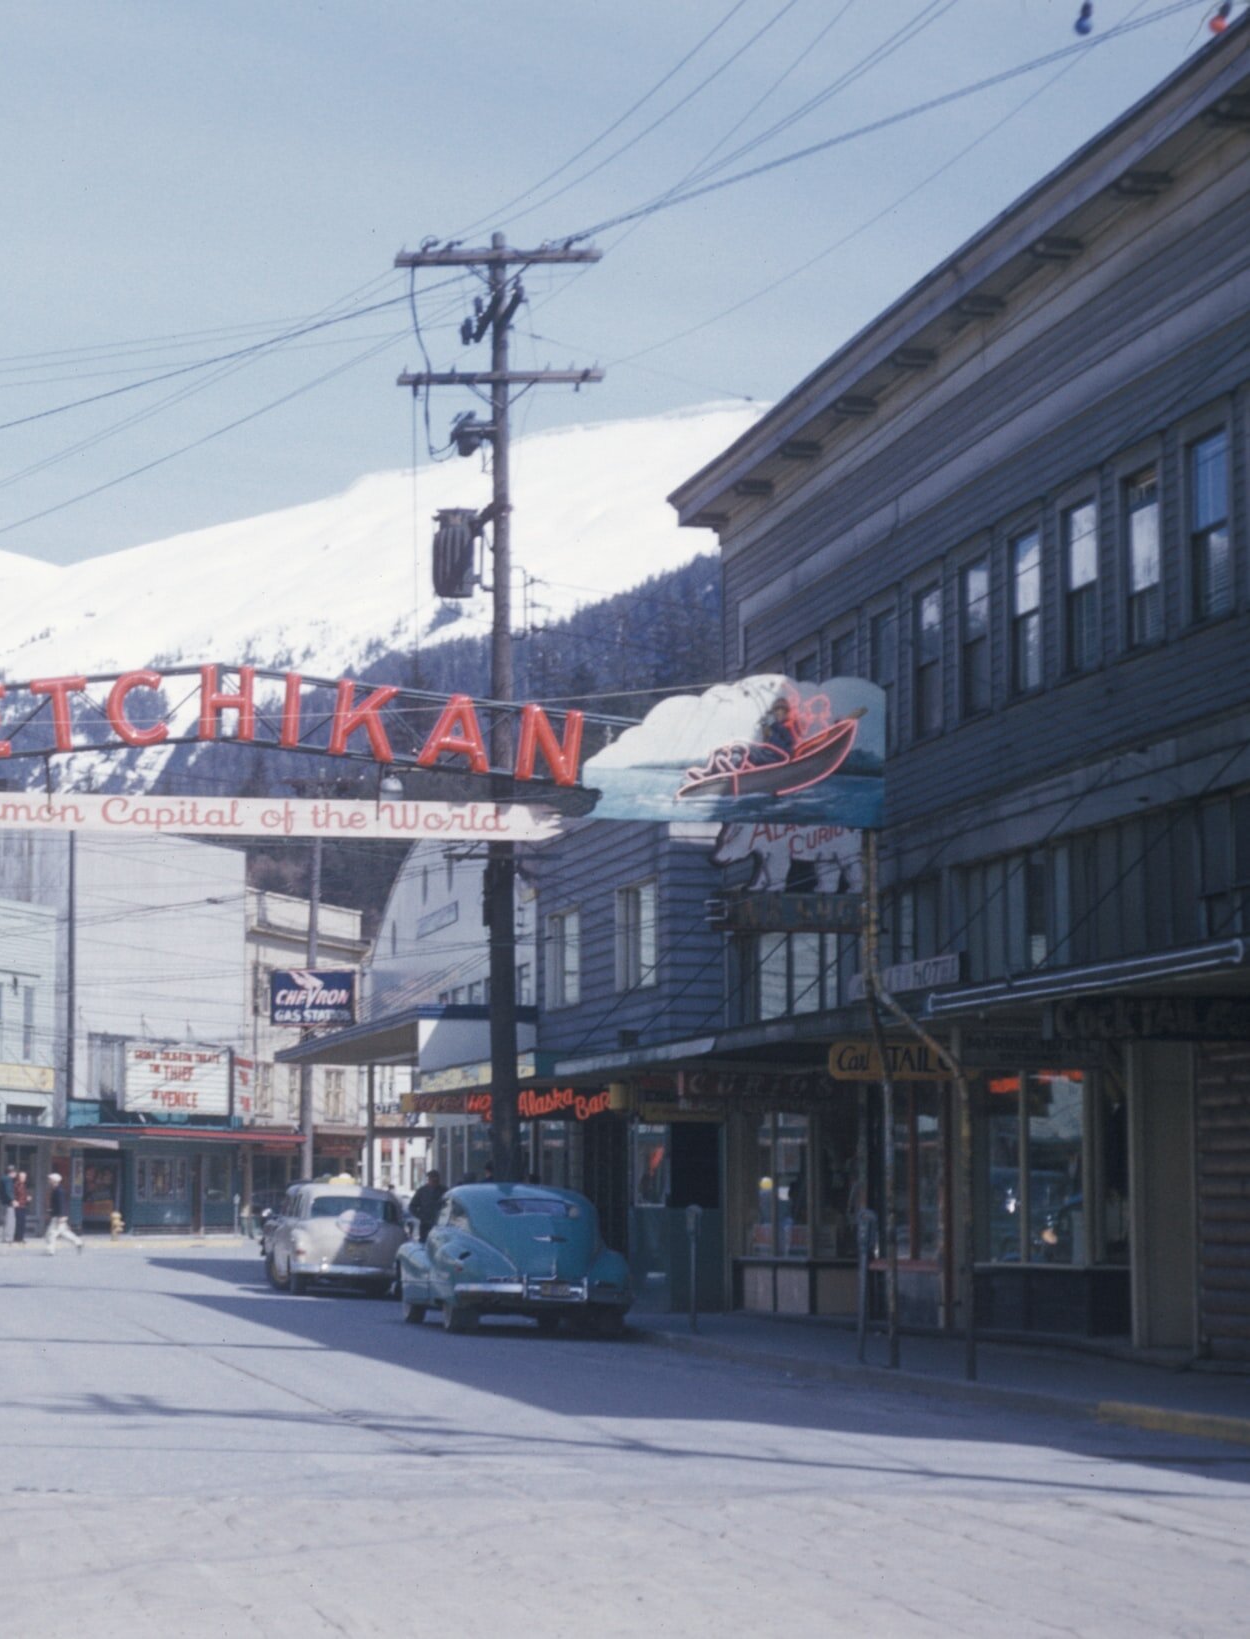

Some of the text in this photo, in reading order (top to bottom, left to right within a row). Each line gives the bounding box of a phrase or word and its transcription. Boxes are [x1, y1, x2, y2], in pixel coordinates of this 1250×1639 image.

[101, 797, 244, 830] Capital
[261, 800, 296, 834] of
[311, 803, 367, 829] the
[379, 804, 510, 832] World
[274, 988, 350, 1010] CHEVRON
[273, 1008, 352, 1022] GAS STATION
[517, 1087, 612, 1121] Alaska Bar
